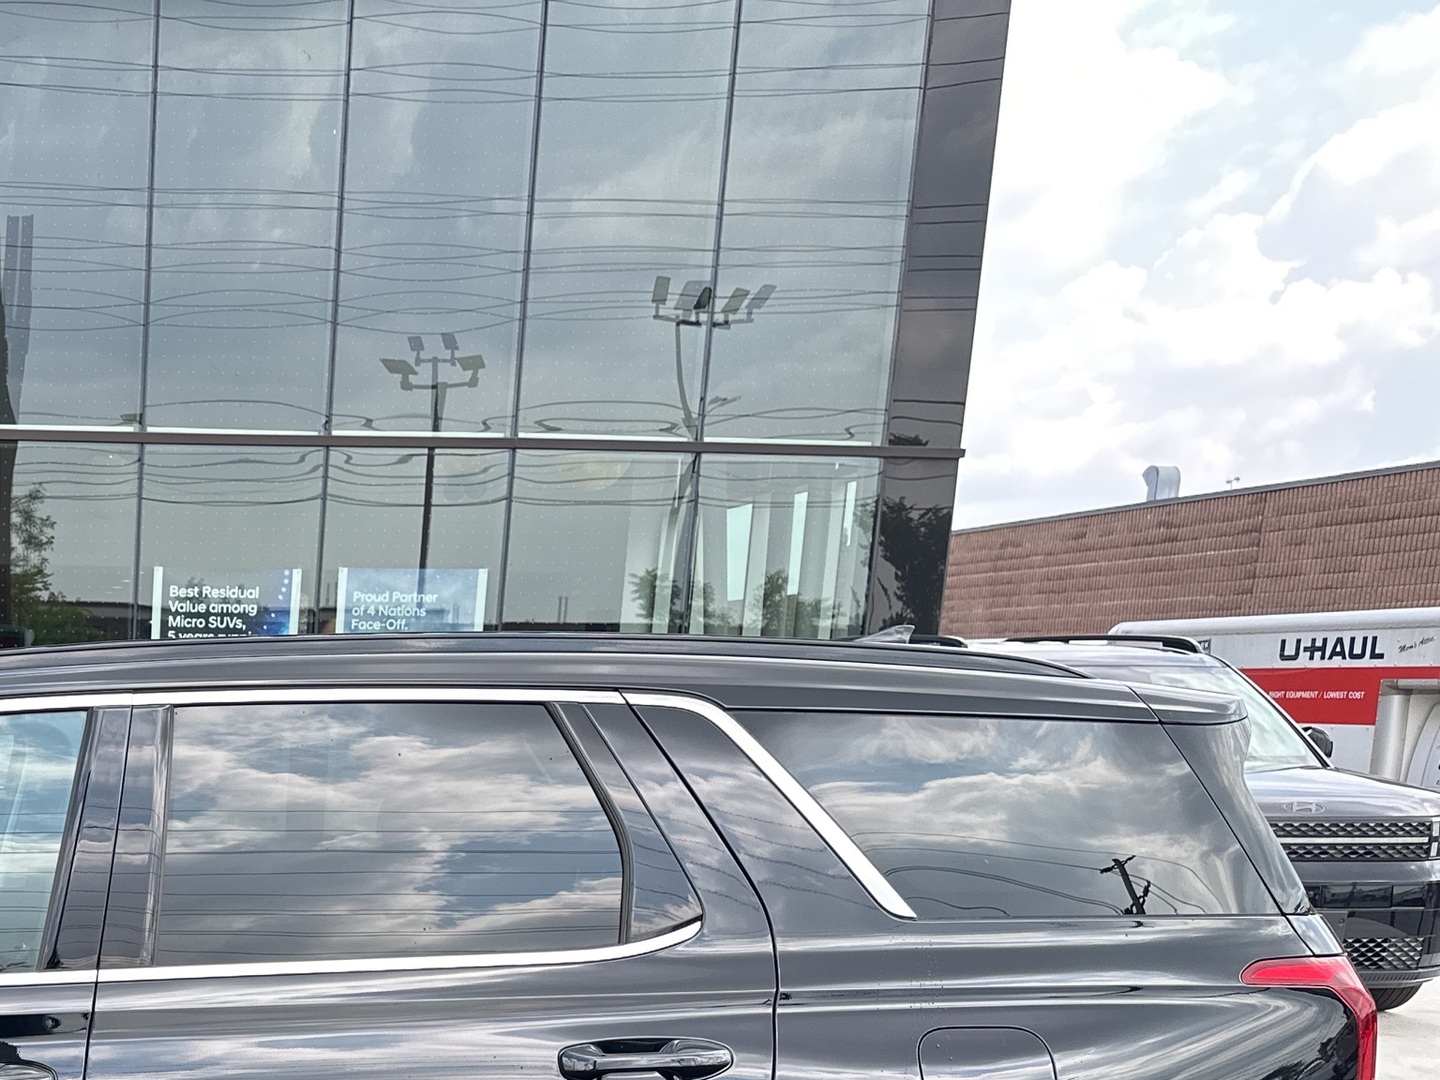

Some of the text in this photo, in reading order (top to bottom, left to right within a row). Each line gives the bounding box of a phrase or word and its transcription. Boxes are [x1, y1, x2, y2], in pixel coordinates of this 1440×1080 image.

[169, 585, 260, 599] Best Residual
[353, 590, 438, 603] Proud Partner
[168, 600, 258, 617] Value among
[352, 605, 427, 617] of 4 Nations
[168, 615, 246, 631] Micro SUVs,
[351, 618, 409, 631] Face-Off.
[1279, 636, 1385, 661] U-HAUL
[1286, 690, 1319, 699] EQUIPMENT
[1323, 691, 1348, 699] LOWEST
[1348, 691, 1365, 699] COST
